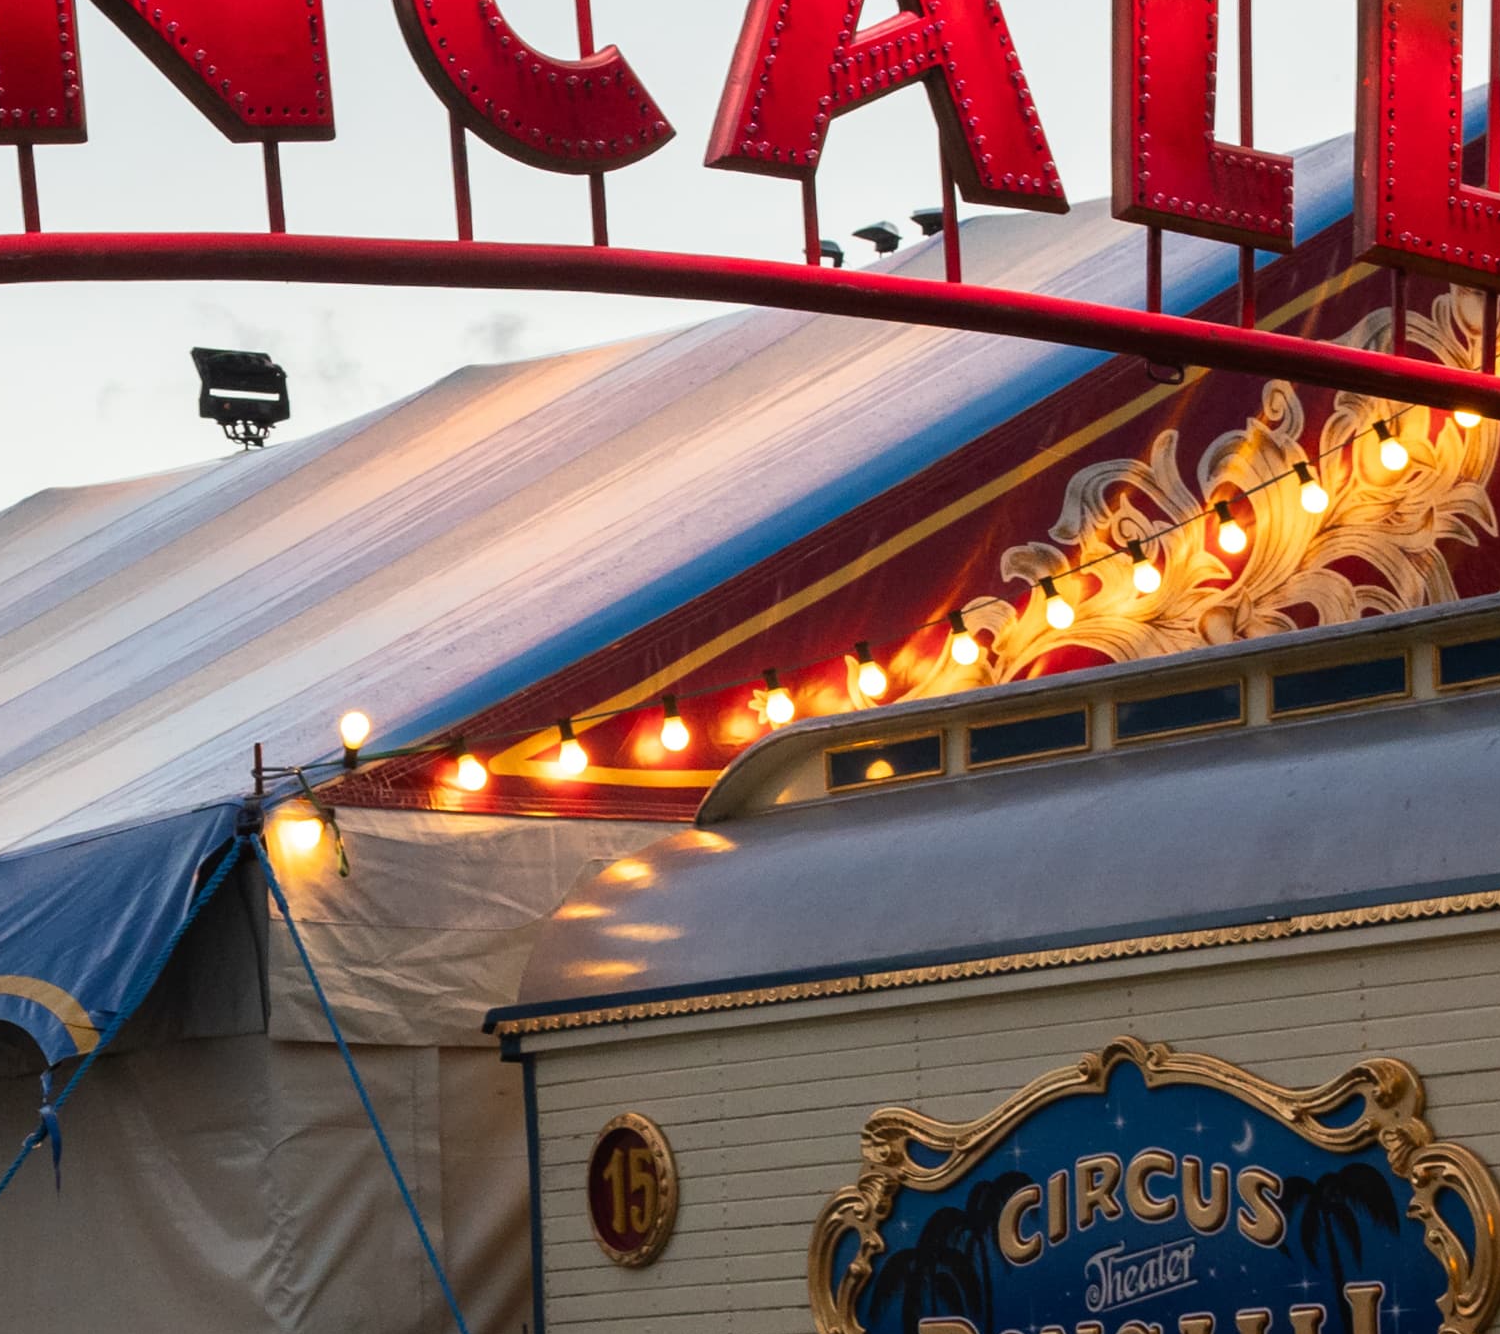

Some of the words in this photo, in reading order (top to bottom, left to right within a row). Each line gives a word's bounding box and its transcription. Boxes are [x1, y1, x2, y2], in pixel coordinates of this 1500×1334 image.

[603, 1147, 658, 1234] 15
[1001, 1146, 1287, 1265] CIRCUS
[1085, 1238, 1197, 1312] Theater
